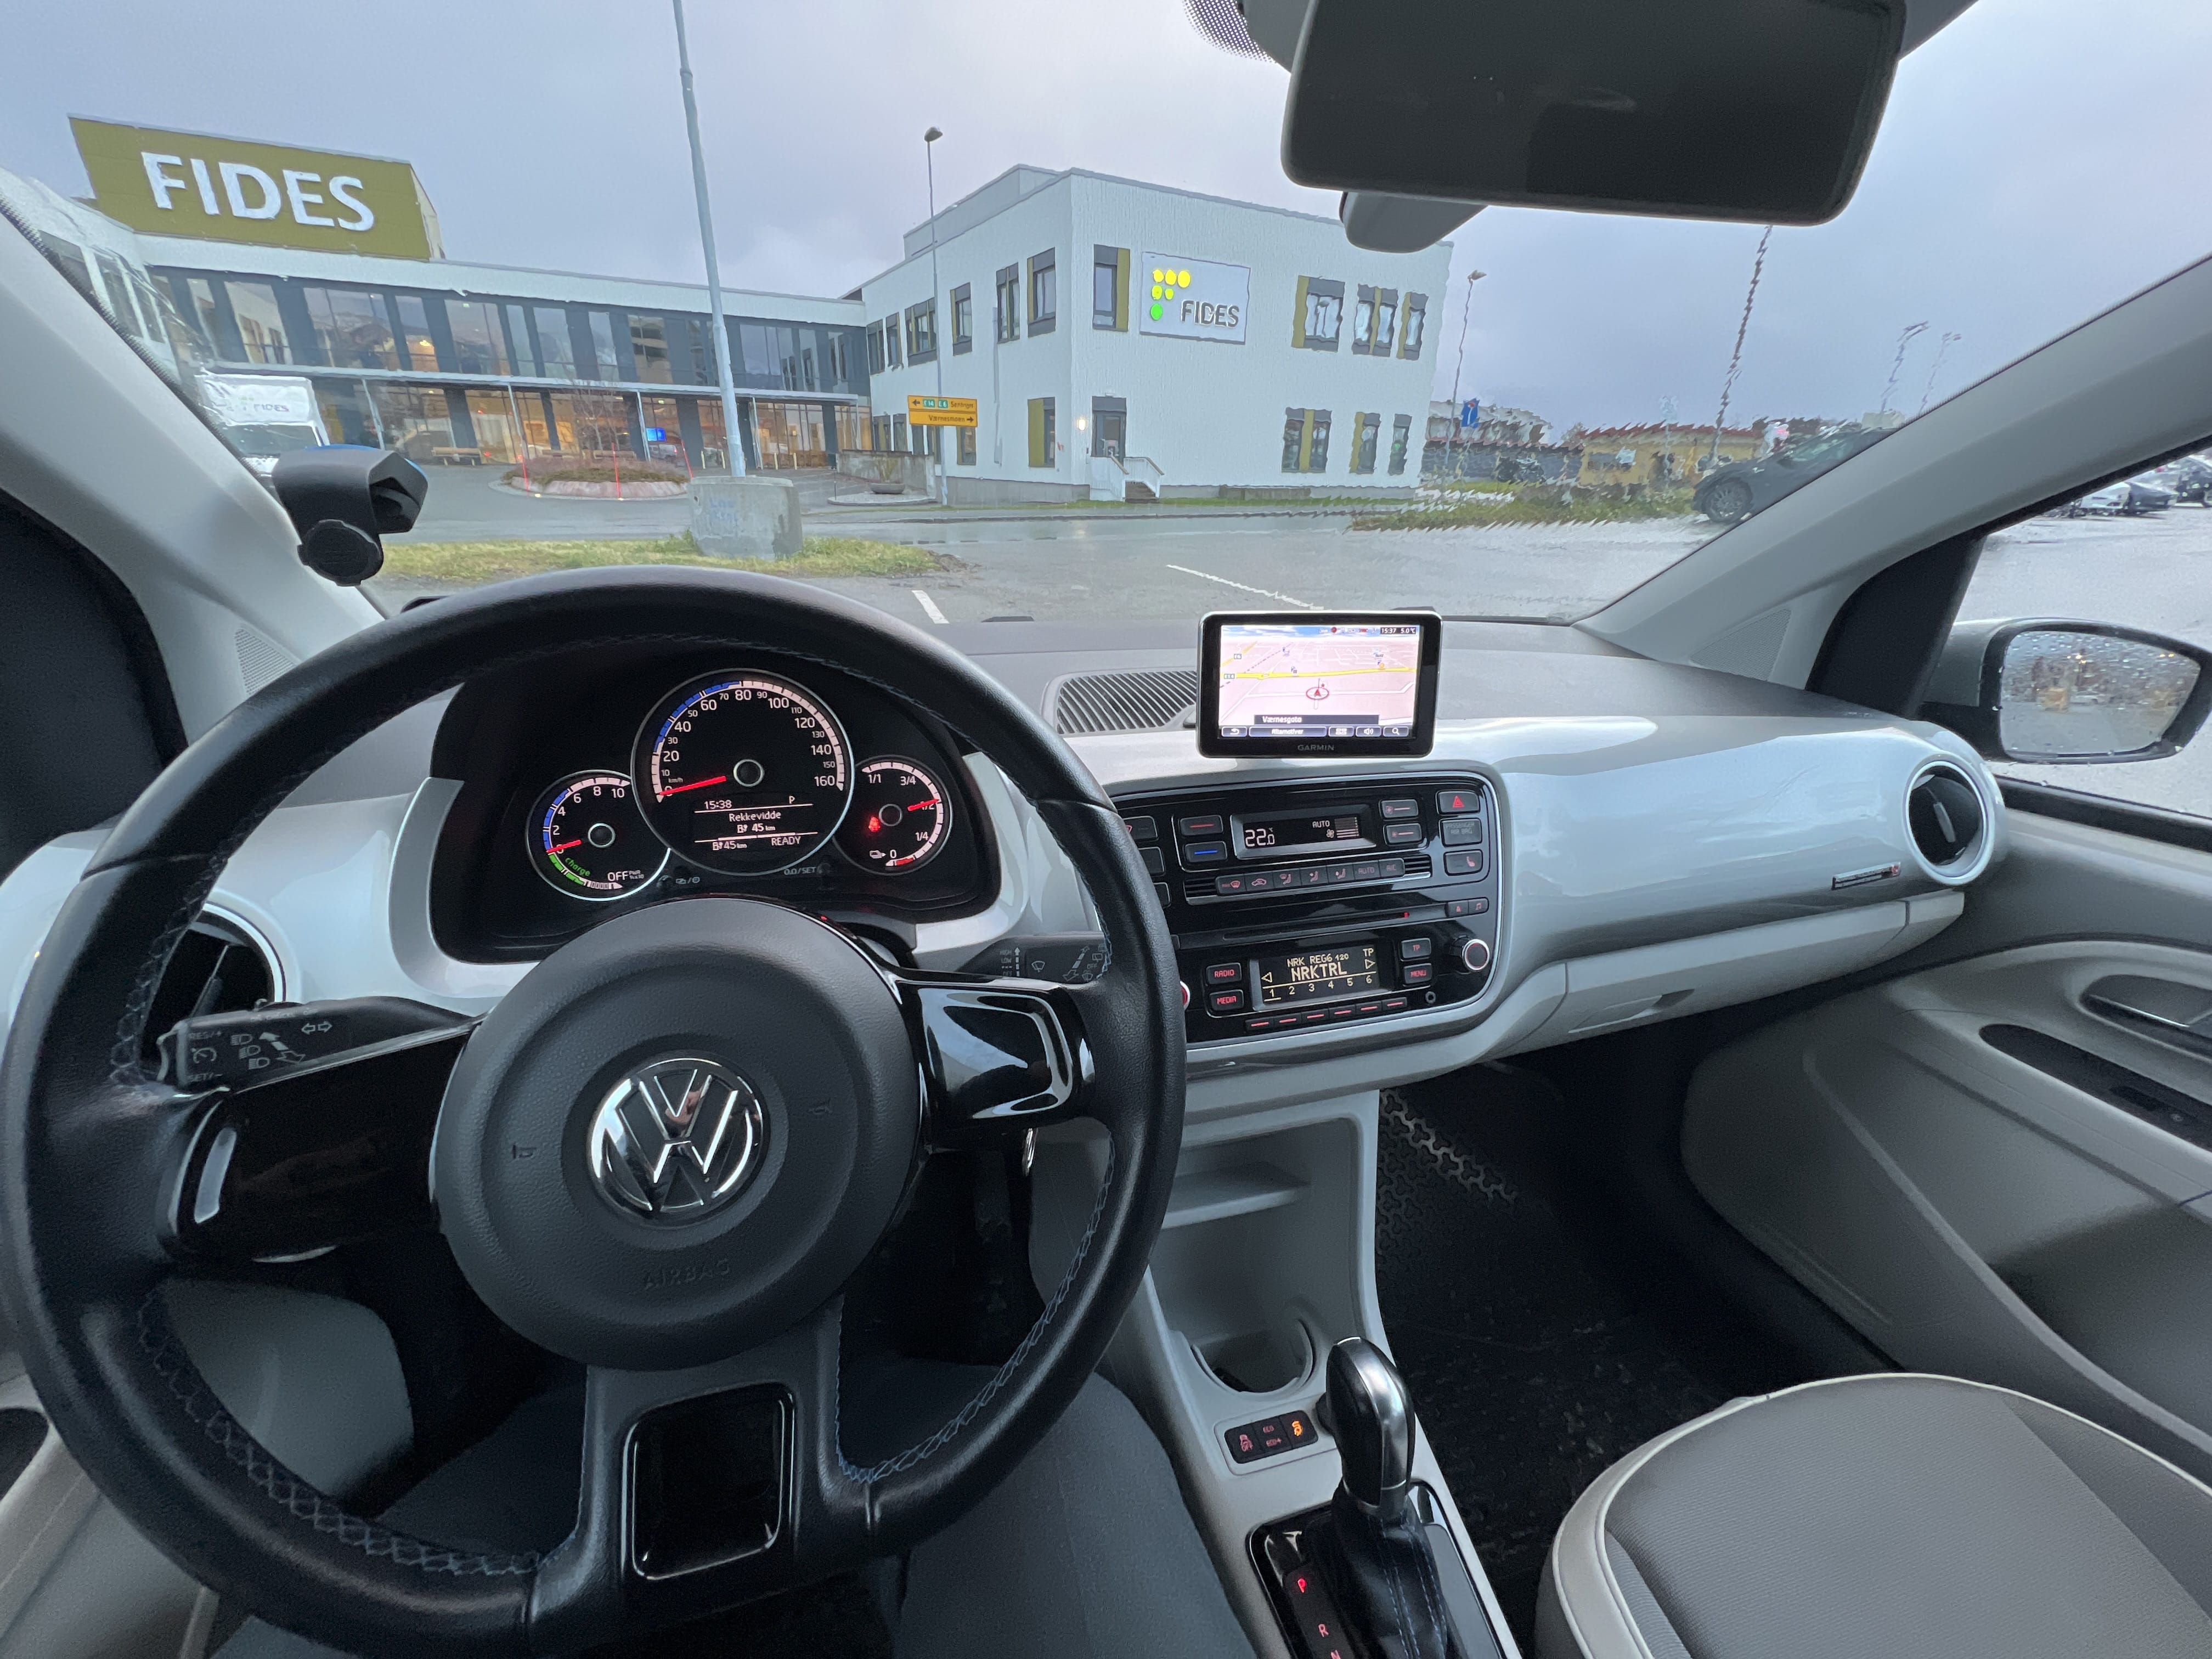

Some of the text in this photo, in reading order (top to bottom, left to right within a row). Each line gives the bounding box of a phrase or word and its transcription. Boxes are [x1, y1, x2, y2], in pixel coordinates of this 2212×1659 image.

[140, 151, 374, 232] FIDES
[1181, 300, 1240, 328] FIDES
[735, 690, 752, 701] 80
[701, 699, 717, 711] 60
[769, 697, 789, 709] 100
[674, 721, 691, 732] 40
[794, 717, 815, 729] 120
[811, 744, 832, 755] 140
[663, 751, 679, 762] 20
[814, 775, 835, 787] 160
[868, 774, 882, 783] 1/1
[900, 776, 916, 786] 3/4
[593, 786, 601, 796] 8
[611, 788, 625, 798] 10
[573, 793, 582, 803] 6
[704, 795, 795, 810] 15:38 P
[557, 806, 566, 816] 4
[729, 810, 782, 822] Rekkevidde
[552, 825, 560, 835] 2
[752, 823, 764, 832] 45
[1312, 820, 1330, 829] AUTO
[915, 831, 929, 841] 1/4
[1245, 828, 1276, 848] 22.0
[724, 840, 737, 850] 45
[771, 836, 801, 846] READY
[889, 849, 897, 858] 0
[565, 857, 591, 877] charge
[607, 871, 629, 882] OFF
[1363, 947, 1374, 957] TP
[1287, 957, 1305, 967] NRK
[1335, 953, 1349, 961] 120
[1214, 969, 1234, 978] RADIO
[1291, 962, 1347, 981] NRKTRL
[1410, 969, 1427, 978] MENU
[1269, 974, 1372, 997] 1 2 3 4 5 6
[1216, 995, 1237, 1005] MEDIA
[1297, 1578, 1307, 1593] P
[1318, 1623, 1329, 1638] R
